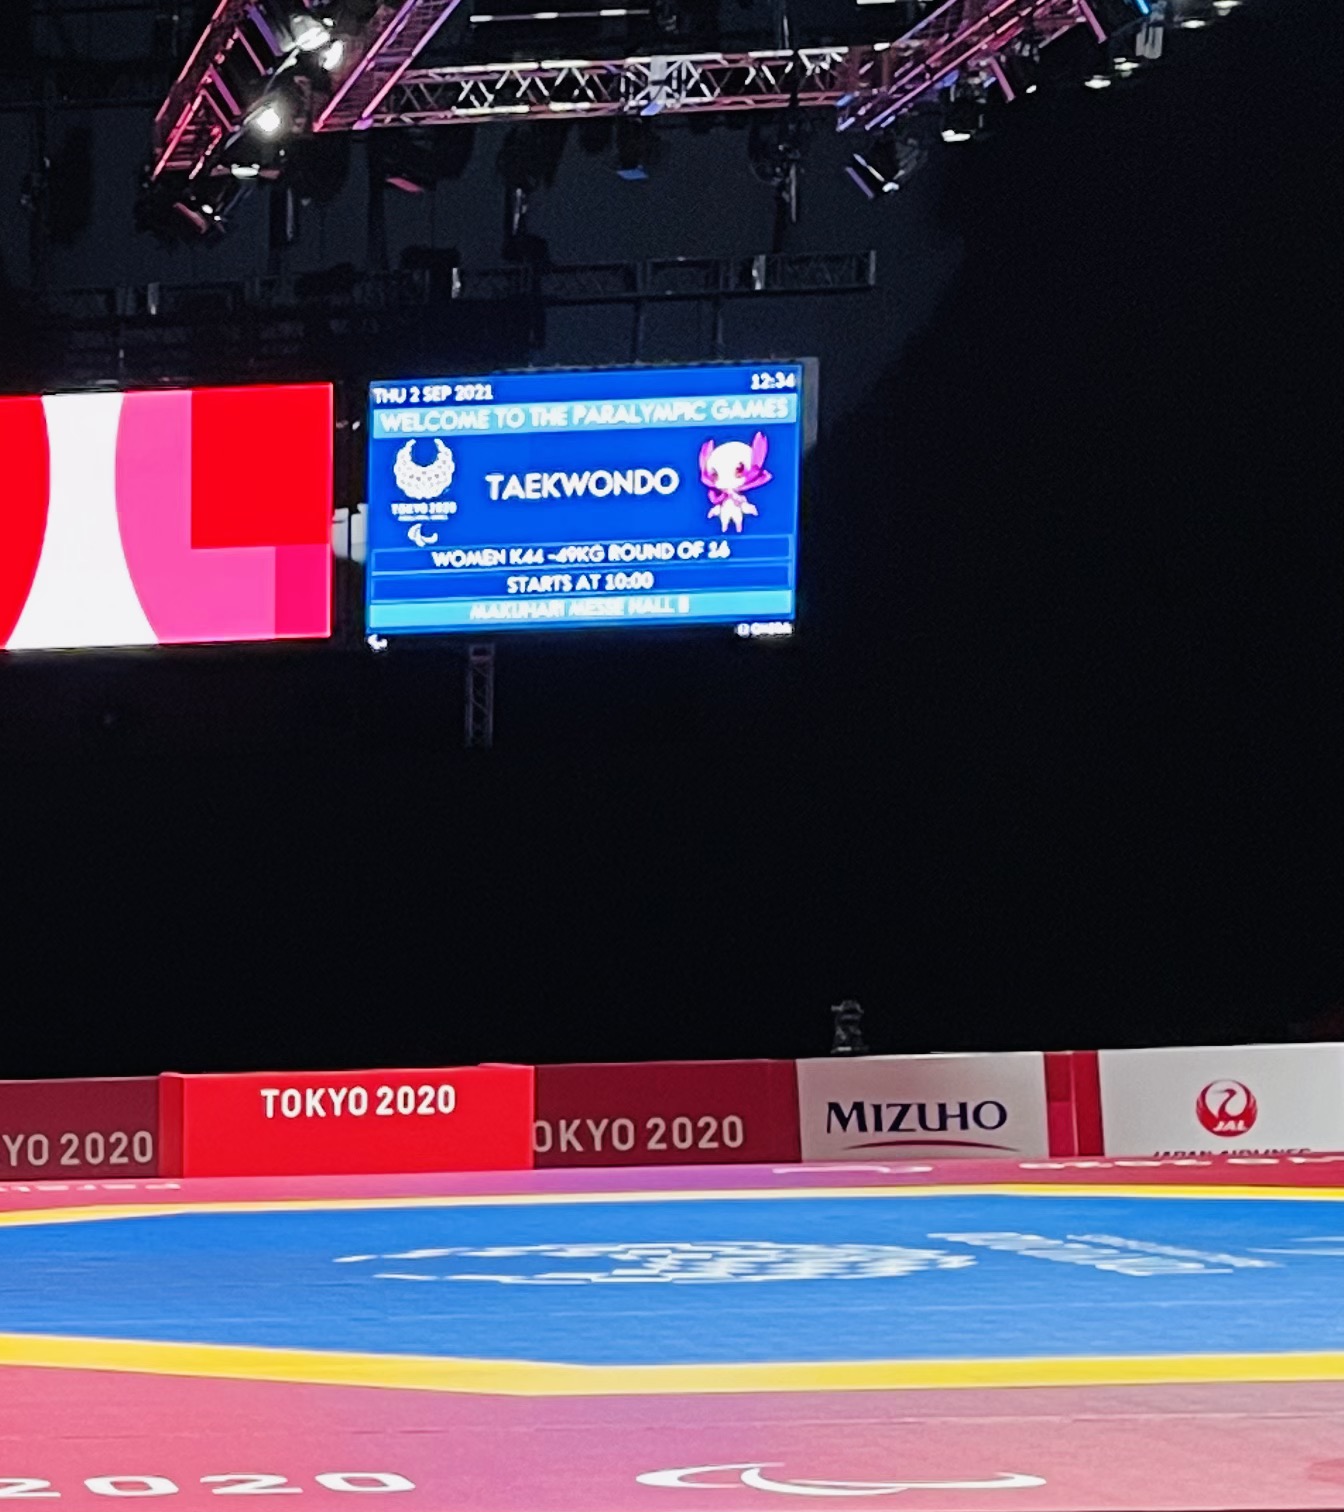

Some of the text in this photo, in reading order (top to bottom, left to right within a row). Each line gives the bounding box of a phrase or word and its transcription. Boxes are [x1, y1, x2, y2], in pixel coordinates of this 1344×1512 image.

[374, 384, 494, 404] THU 2 SEP 2021
[750, 371, 796, 391] 12:34
[380, 398, 789, 432] WELCOME TO THE PARALYMPIC GAMES
[485, 466, 680, 501] TAEKWONDO
[432, 548, 506, 568] WOMEN
[510, 547, 545, 565] K44
[608, 542, 674, 561] ROUND
[676, 541, 705, 558] OF
[708, 540, 731, 558] 16
[507, 570, 654, 593] STARTS AT 10:00
[261, 1084, 456, 1119] TOKYO 2020
[827, 1101, 1009, 1134] MIZUHO
[645, 1114, 744, 1150] 2020
[1213, 1119, 1250, 1132] JAL
[59, 1130, 154, 1166] 2020
